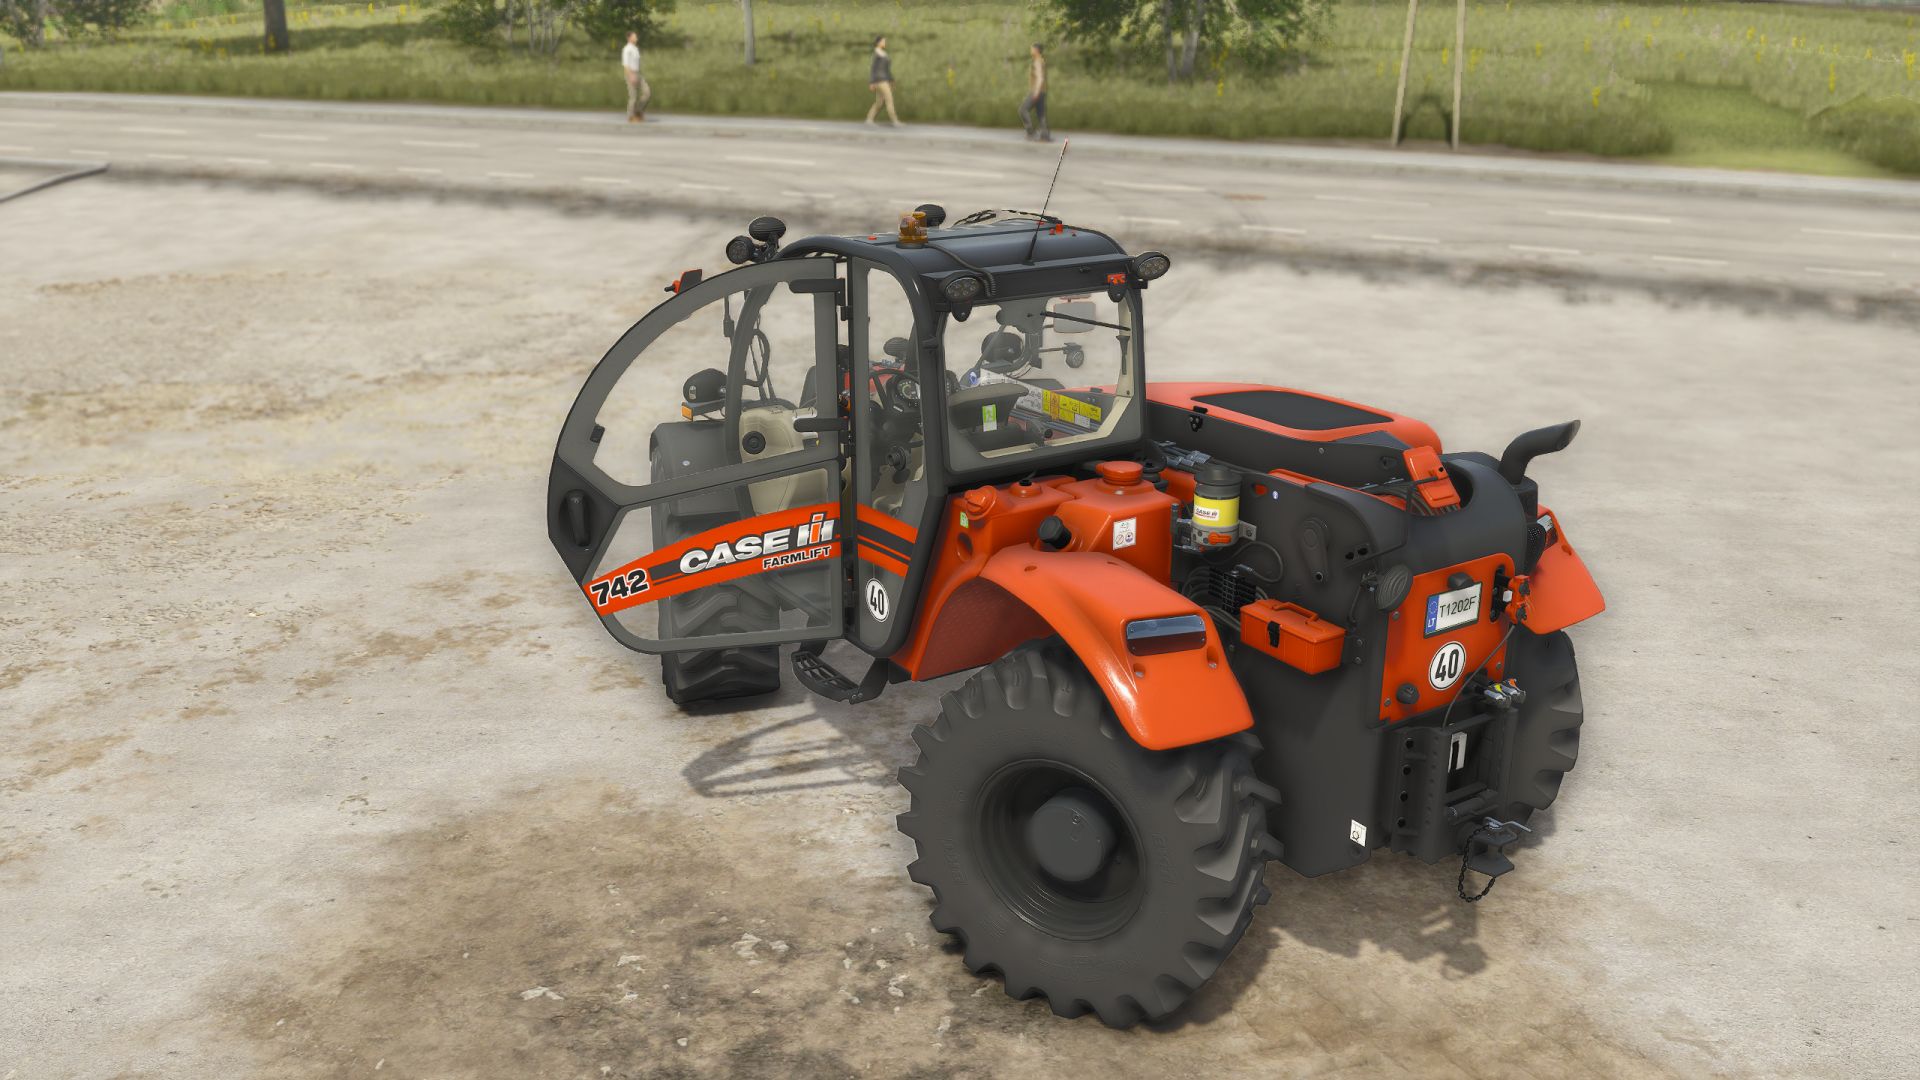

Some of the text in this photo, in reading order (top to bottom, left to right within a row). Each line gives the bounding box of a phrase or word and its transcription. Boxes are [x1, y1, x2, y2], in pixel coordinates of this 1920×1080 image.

[680, 528, 790, 574] CASE
[763, 546, 832, 569] FARMLIFT
[591, 568, 649, 606] 742
[870, 584, 885, 620] 40
[1428, 617, 1436, 628] LT
[1440, 597, 1476, 618] T1202F
[1435, 649, 1460, 681] 40
